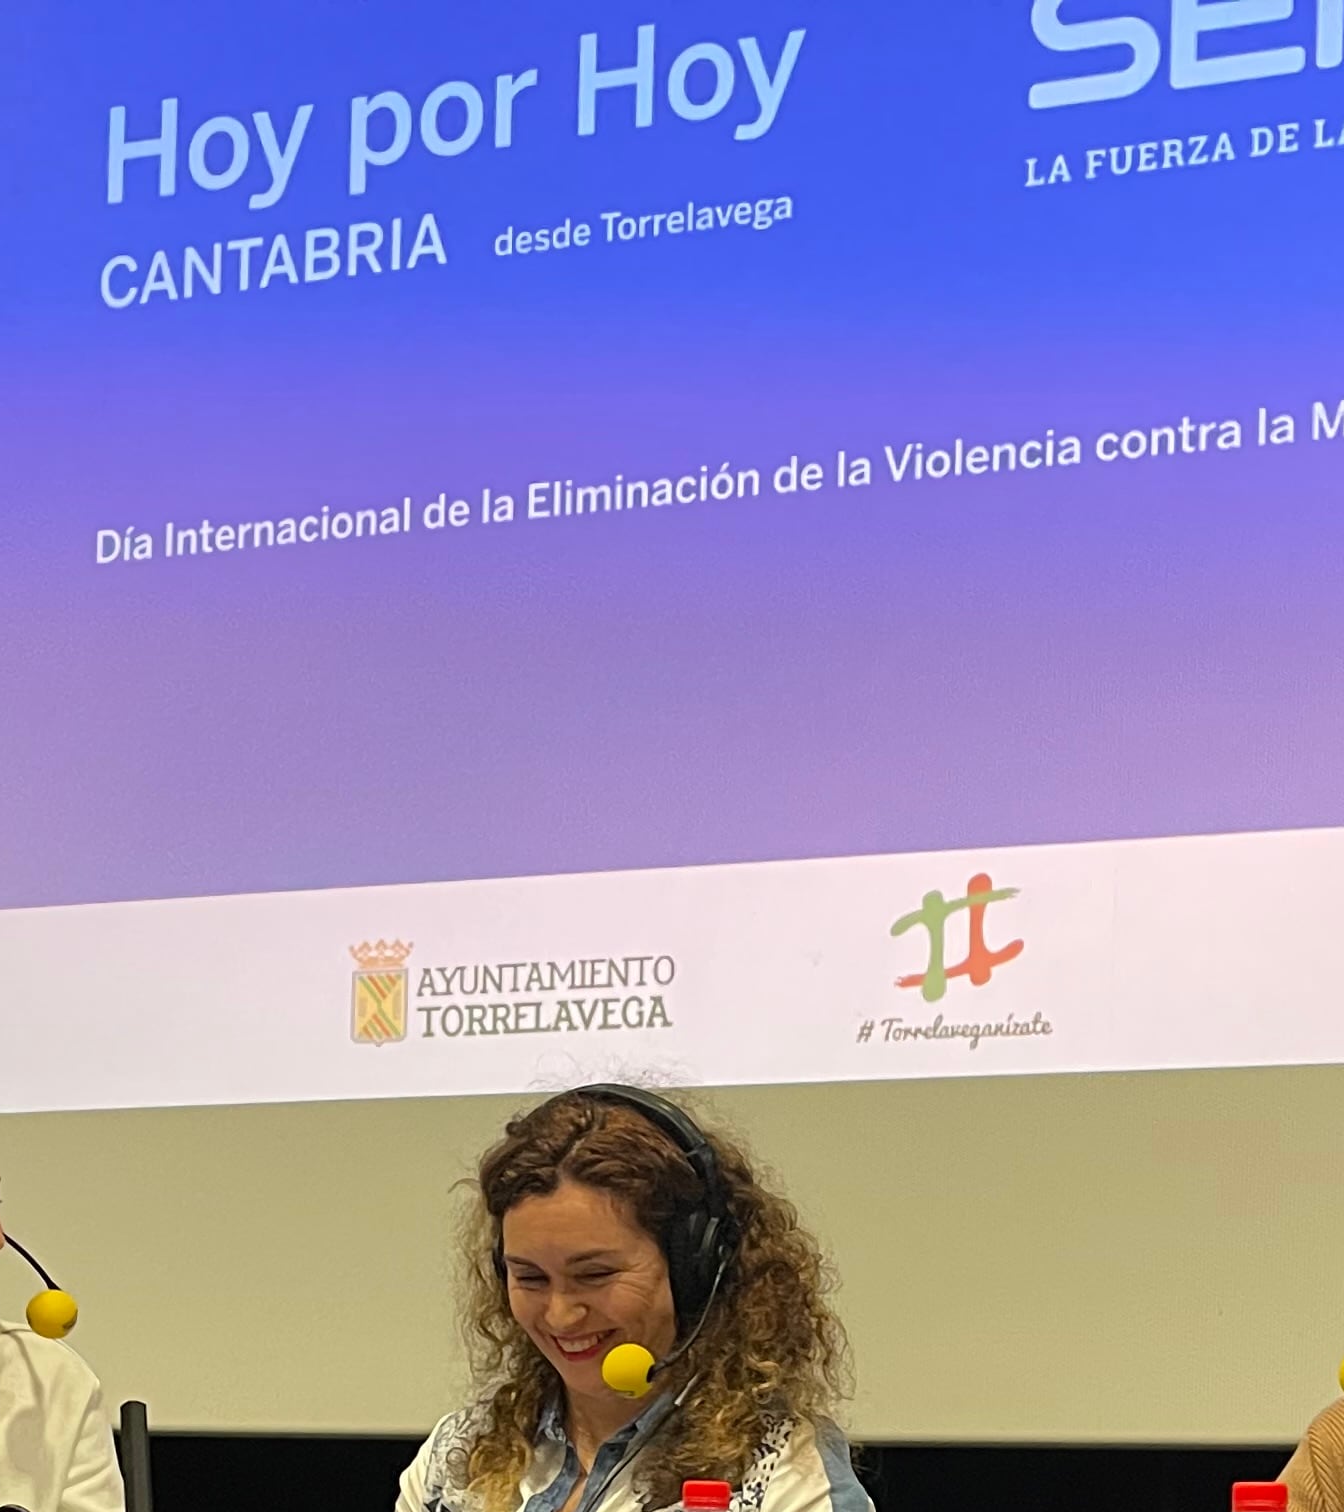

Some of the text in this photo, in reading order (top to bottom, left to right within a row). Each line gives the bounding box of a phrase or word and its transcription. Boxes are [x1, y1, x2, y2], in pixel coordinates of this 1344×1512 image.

[108, 24, 806, 209] Hoy por Hoy
[1025, 155, 1071, 186] LA
[1086, 133, 1235, 178] FUERZA
[1250, 123, 1299, 157] DE
[101, 197, 792, 308] CANTABRIA desde Torrelavega
[97, 527, 152, 563] Día
[166, 498, 410, 557] Internacional
[424, 493, 469, 529] de
[483, 489, 513, 523] la
[528, 463, 759, 518] Eliminación
[774, 456, 823, 493] de
[838, 451, 870, 487] la
[885, 430, 1080, 481] Violencia
[1096, 417, 1241, 461] contra
[1258, 408, 1294, 445] la
[417, 956, 674, 997] AYUNTAMIENTO
[417, 993, 673, 1038] TORRELAVEGA
